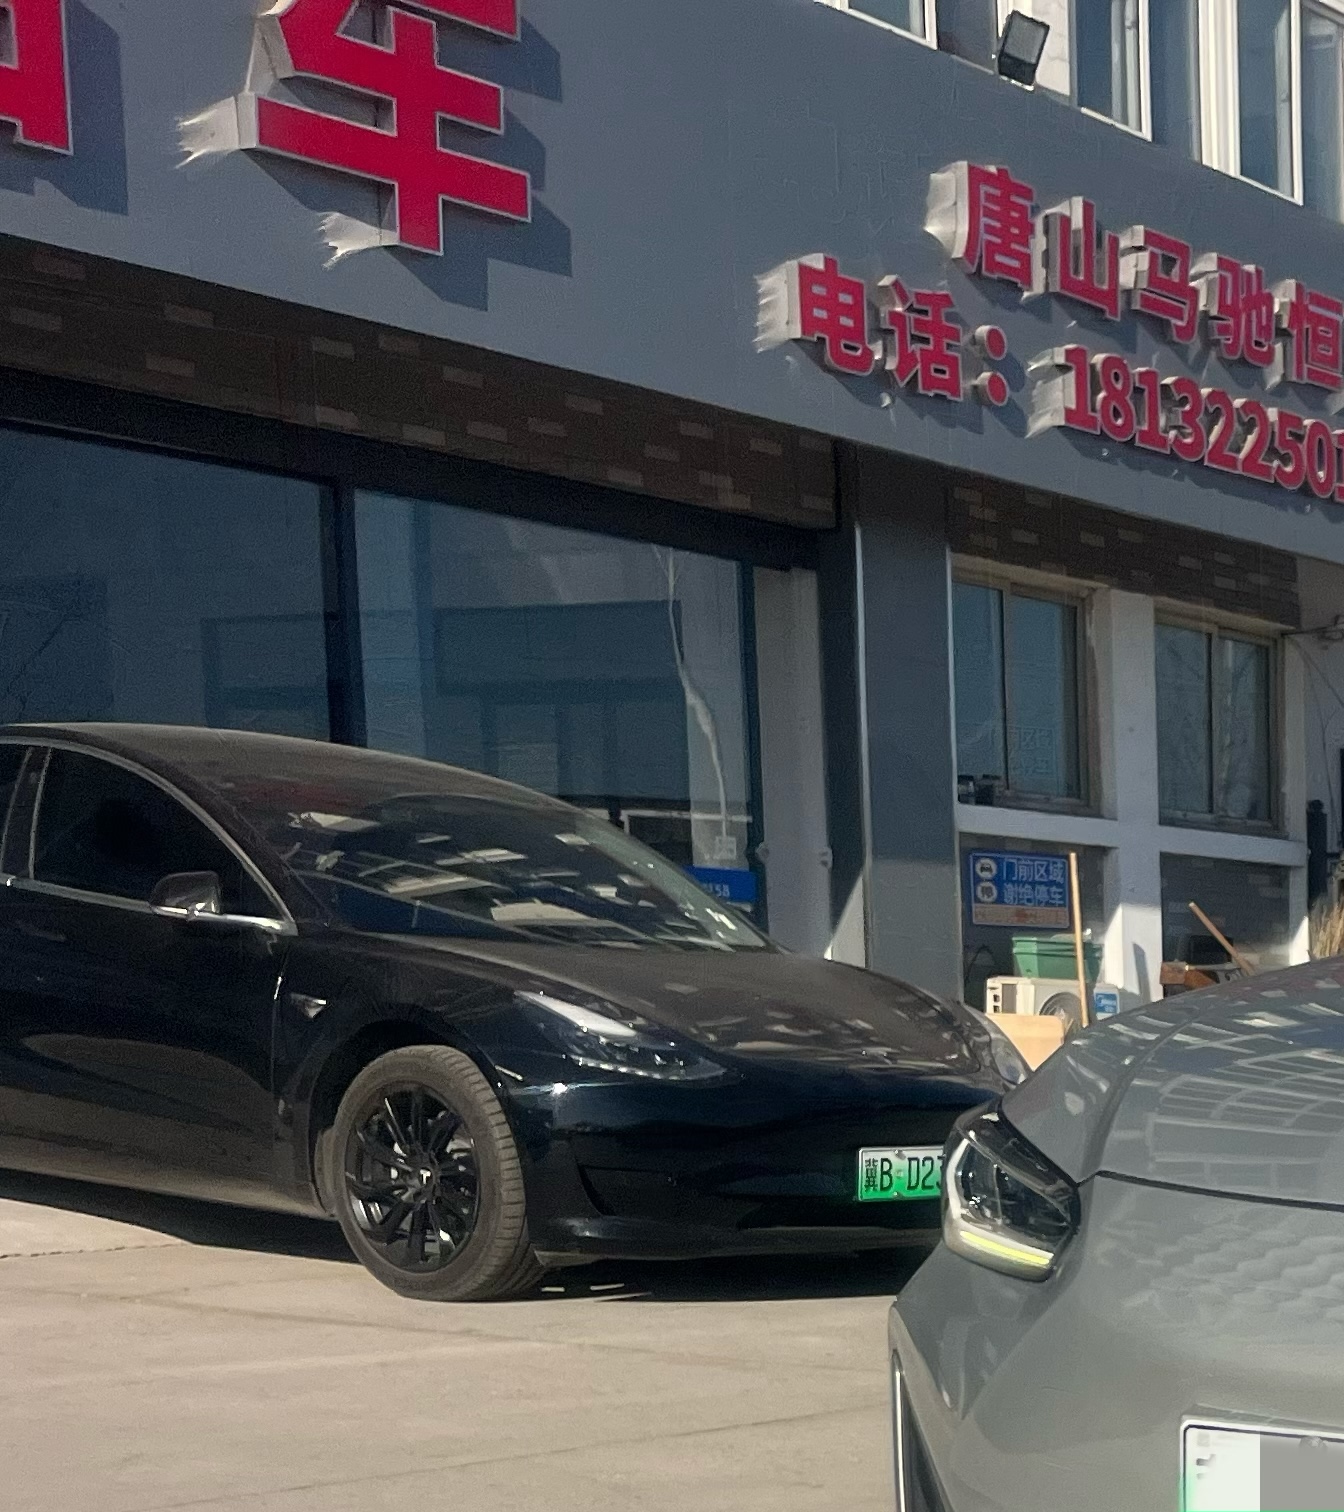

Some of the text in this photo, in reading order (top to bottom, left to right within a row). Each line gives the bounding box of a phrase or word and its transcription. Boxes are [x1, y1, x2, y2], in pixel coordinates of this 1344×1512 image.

[1002, 857, 1065, 884] 门前区域
[1002, 882, 1065, 907] 谢绝停车
